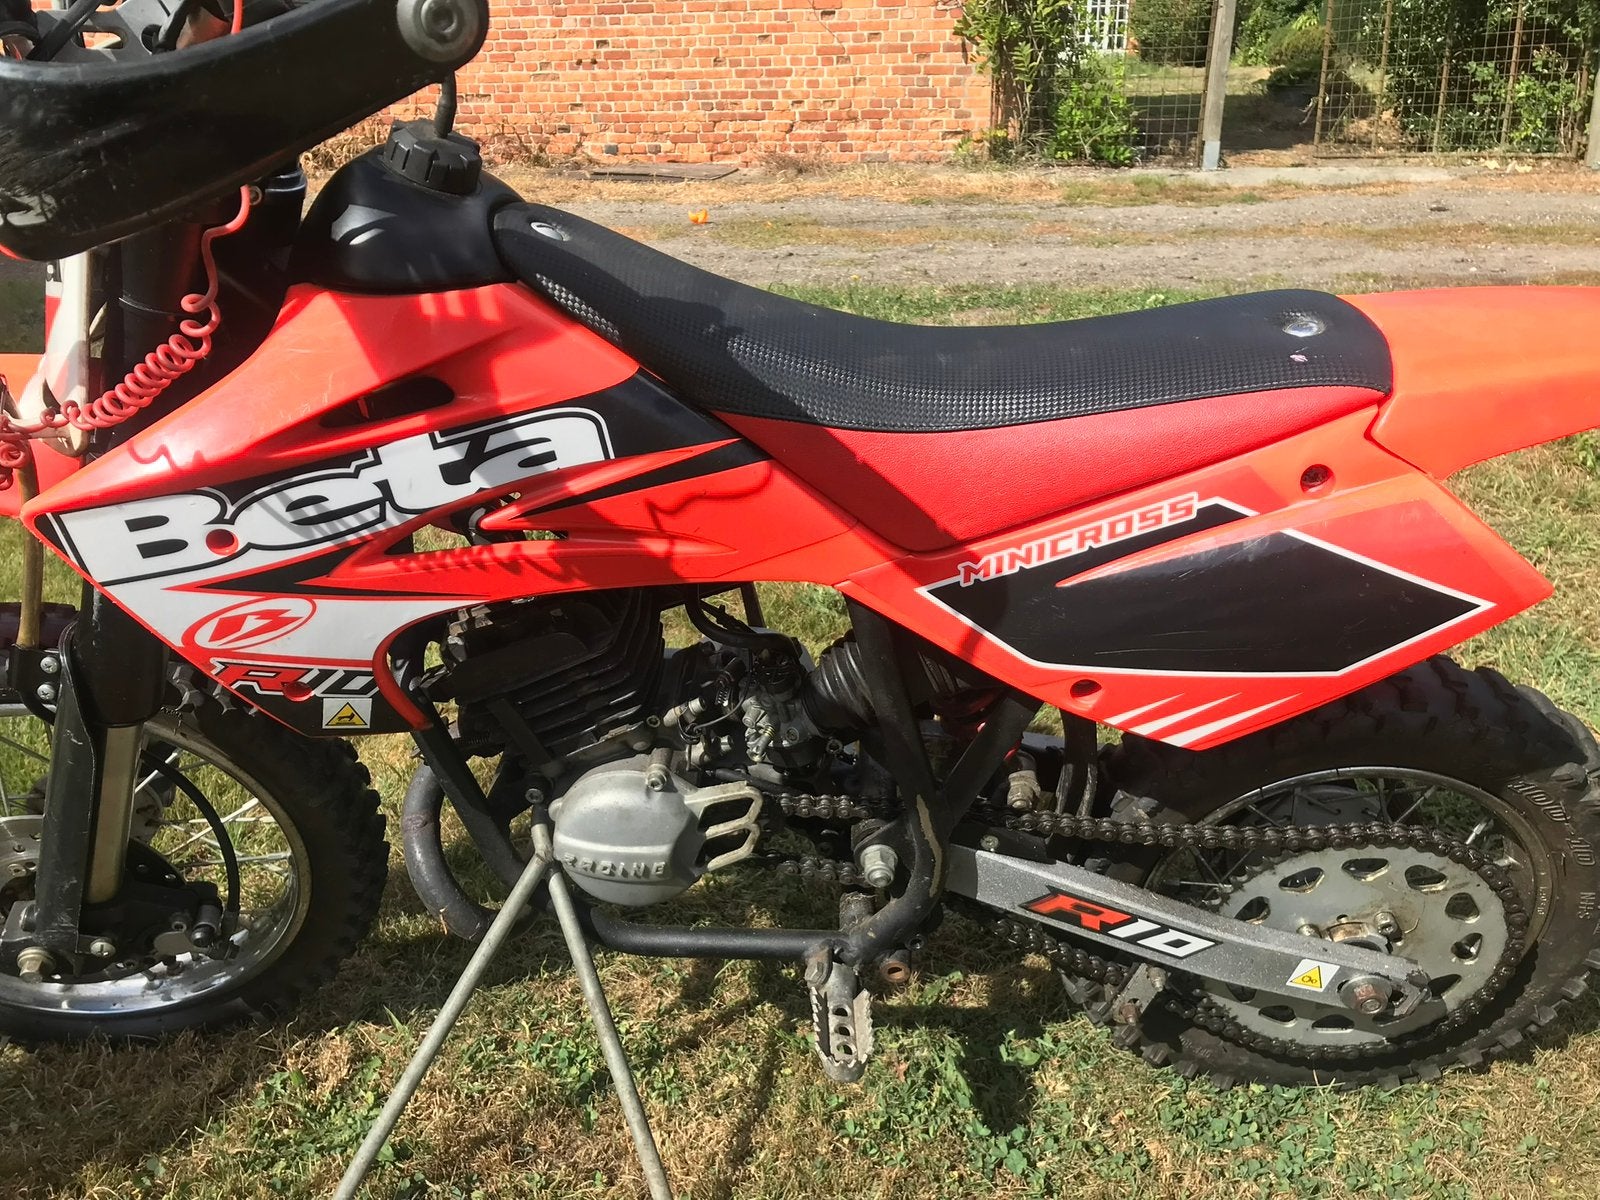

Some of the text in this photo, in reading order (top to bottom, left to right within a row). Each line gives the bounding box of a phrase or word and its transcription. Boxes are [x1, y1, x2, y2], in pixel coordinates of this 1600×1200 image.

[62, 408, 612, 582] Beta
[958, 492, 1198, 587] MINICROSS
[212, 657, 379, 698] R10
[563, 853, 665, 876] RACING
[1022, 888, 1221, 958] R10
